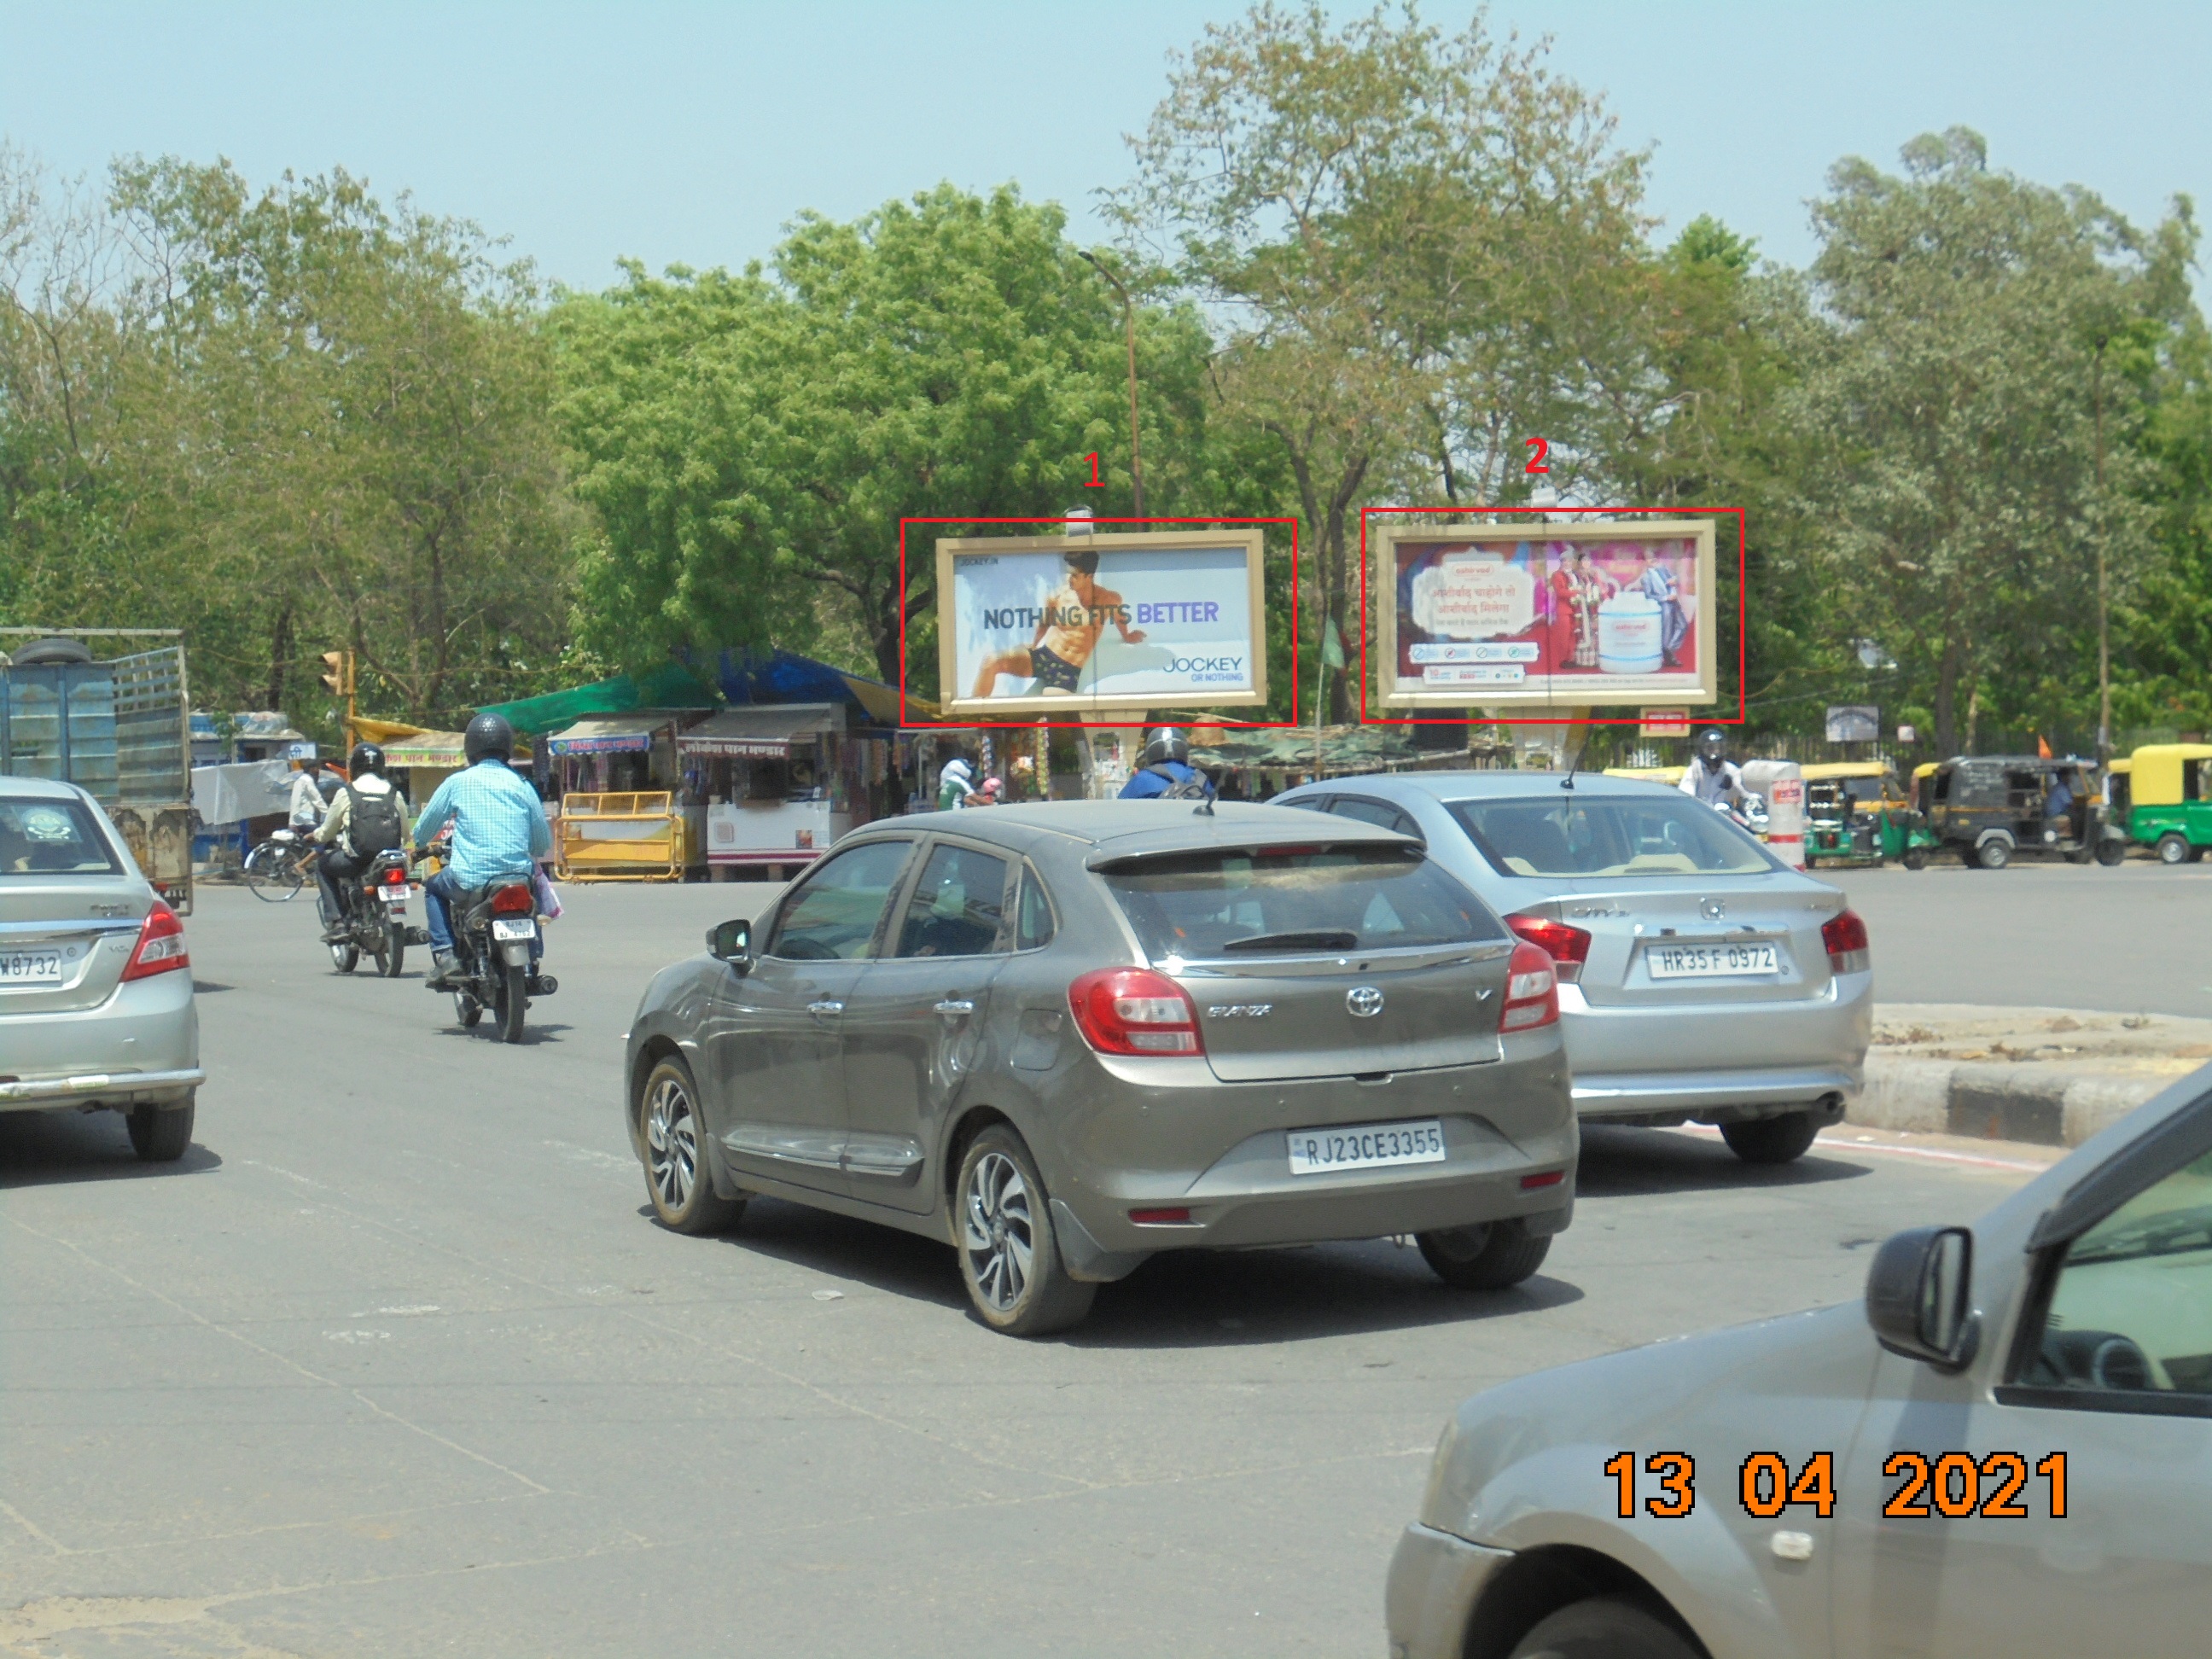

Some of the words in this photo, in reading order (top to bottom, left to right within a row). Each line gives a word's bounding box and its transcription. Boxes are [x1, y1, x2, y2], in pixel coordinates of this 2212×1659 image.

[984, 605, 1082, 629] NOTHING
[1089, 604, 1132, 626] FITS
[1138, 602, 1220, 624] BETTER
[1163, 656, 1243, 672] JOCKEY
[1191, 673, 1203, 682] OR
[1205, 672, 1243, 681] NOTHING
[405, 754, 423, 763] पान
[1662, 949, 1707, 972] HR35
[1713, 949, 1720, 969] F
[1729, 947, 1773, 969] 0972
[1307, 1128, 1440, 1166] RJ23CE3355
